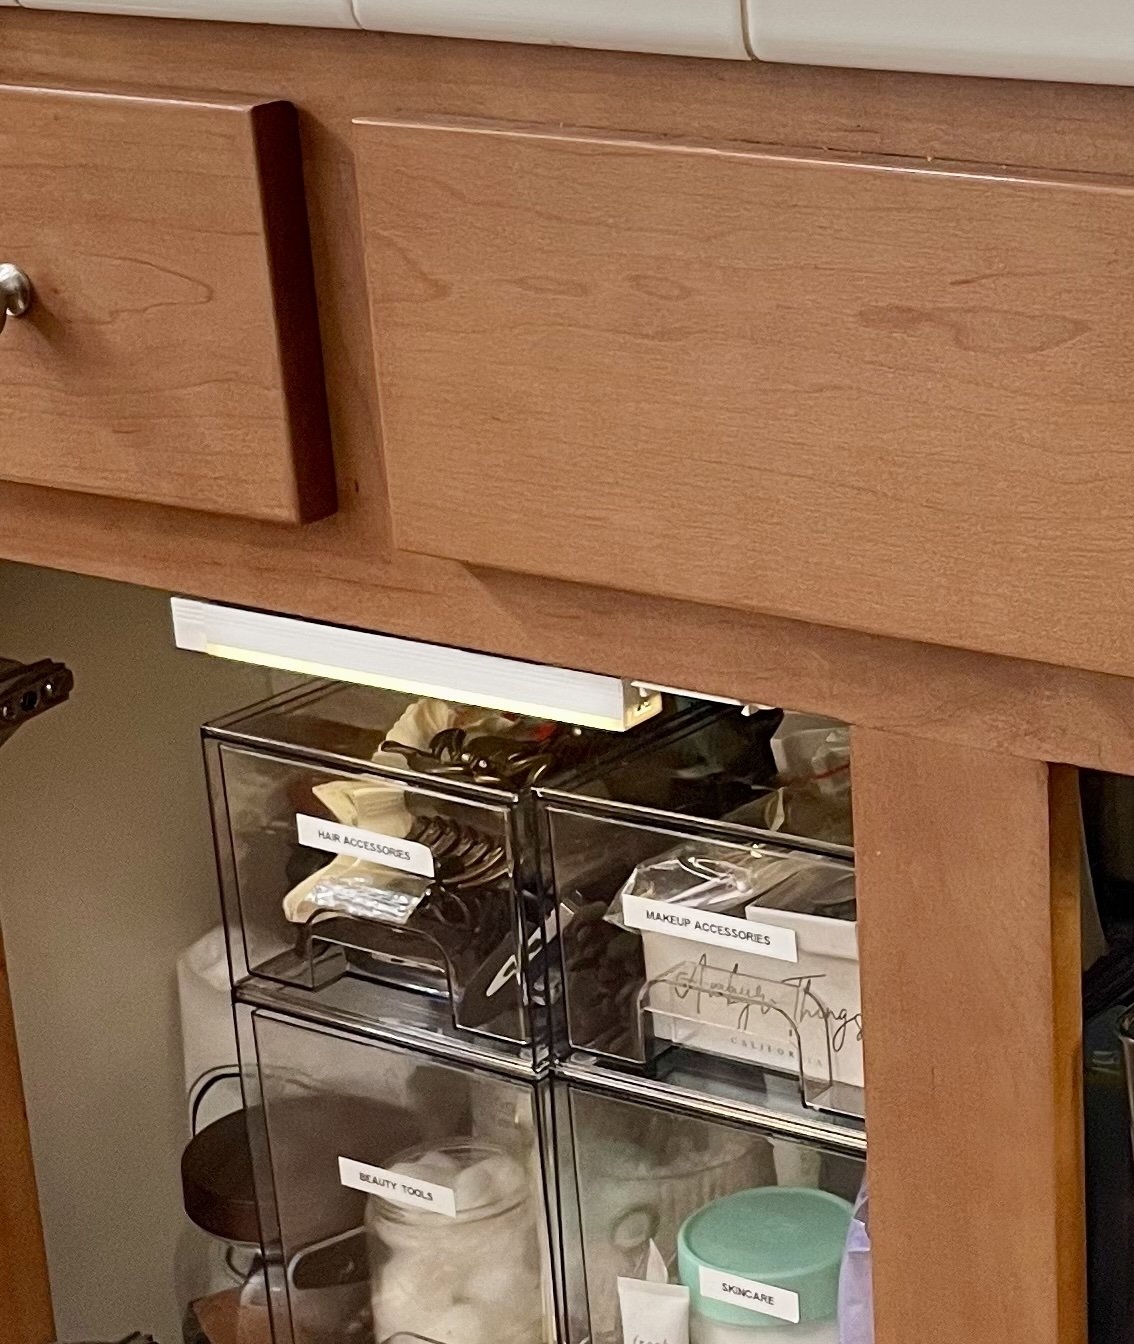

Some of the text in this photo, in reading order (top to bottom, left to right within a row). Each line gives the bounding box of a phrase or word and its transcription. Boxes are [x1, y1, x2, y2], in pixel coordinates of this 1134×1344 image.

[318, 830, 411, 861] HAIR ACCESSORIES
[646, 910, 771, 945] MAKEUP ACCESSORIES
[730, 1036, 823, 1067] CALIFORIA
[360, 1172, 433, 1201] BEAUTY TOOLS
[722, 1283, 775, 1306] SKINCARE
